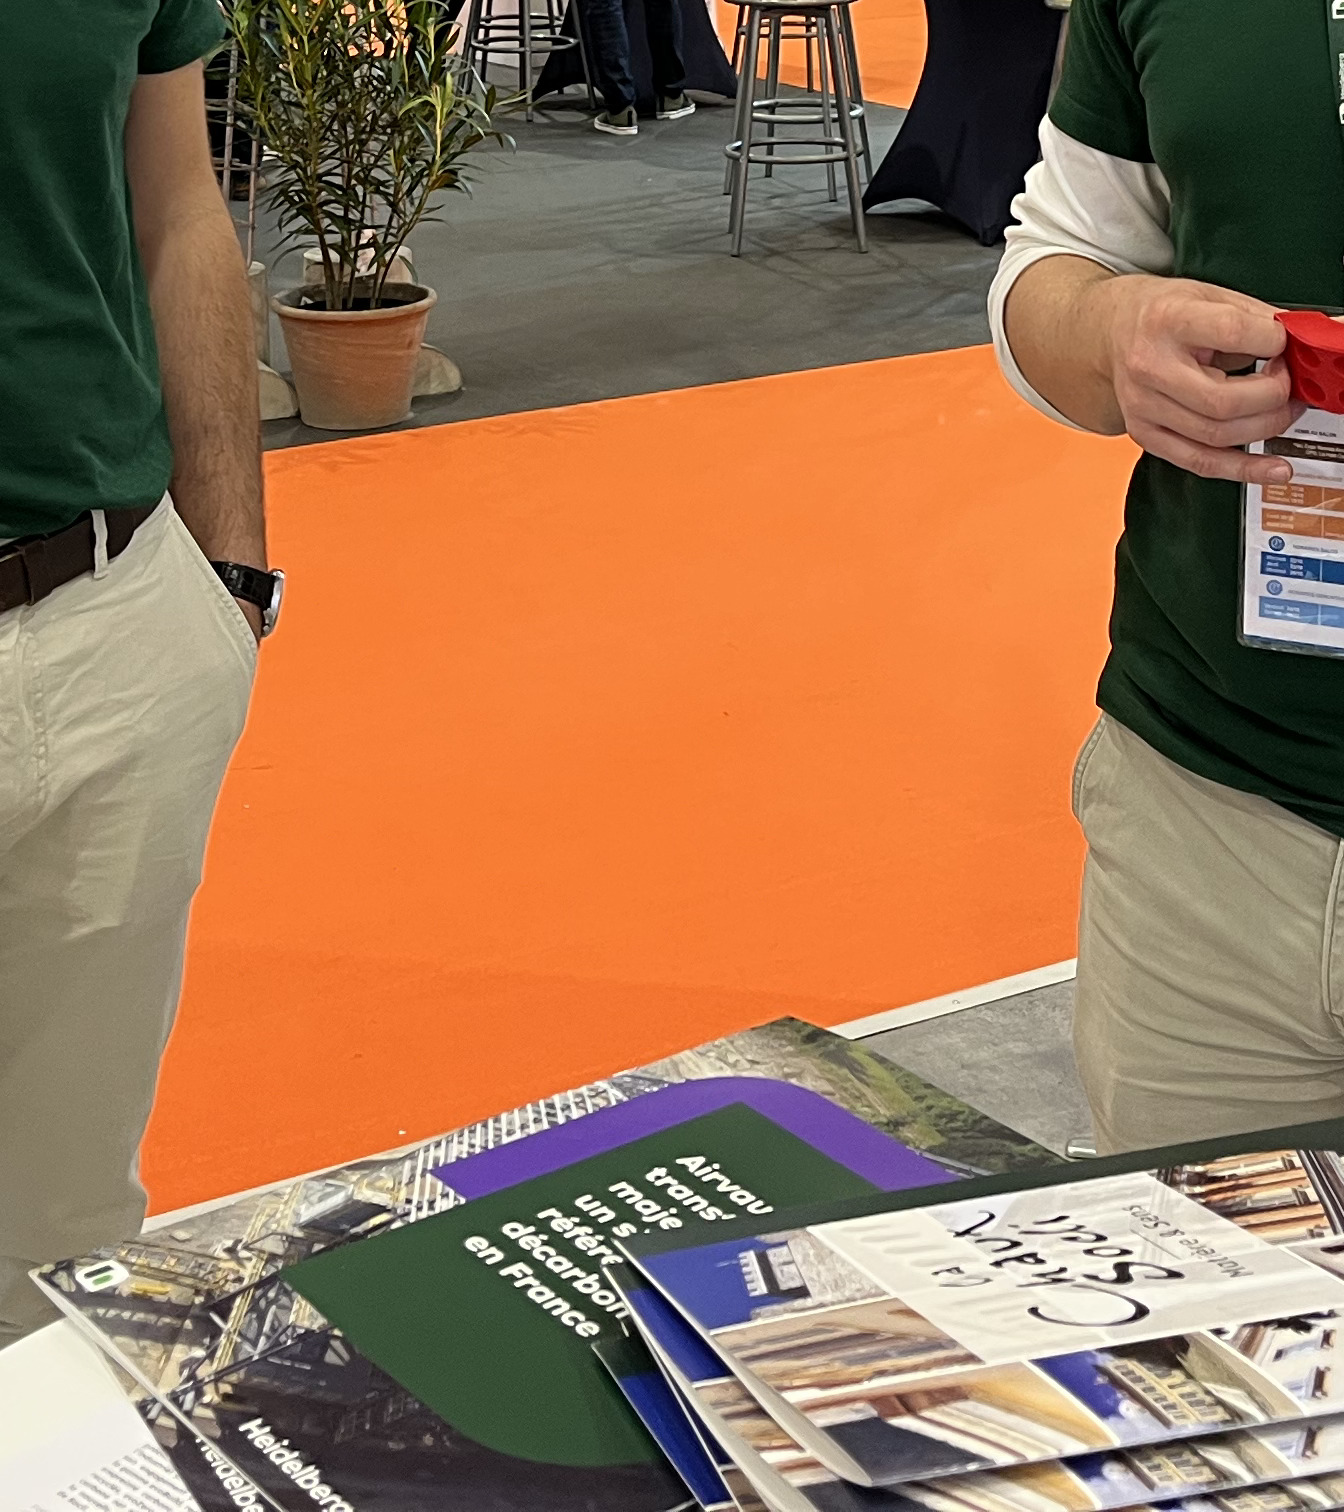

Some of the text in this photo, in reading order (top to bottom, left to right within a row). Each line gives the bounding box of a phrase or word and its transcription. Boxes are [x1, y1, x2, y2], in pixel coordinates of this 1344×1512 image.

[574, 1194, 616, 1224] un
[645, 1167, 737, 1222] trans
[1122, 1205, 1171, 1229] Sens
[464, 1235, 601, 1338] en France
